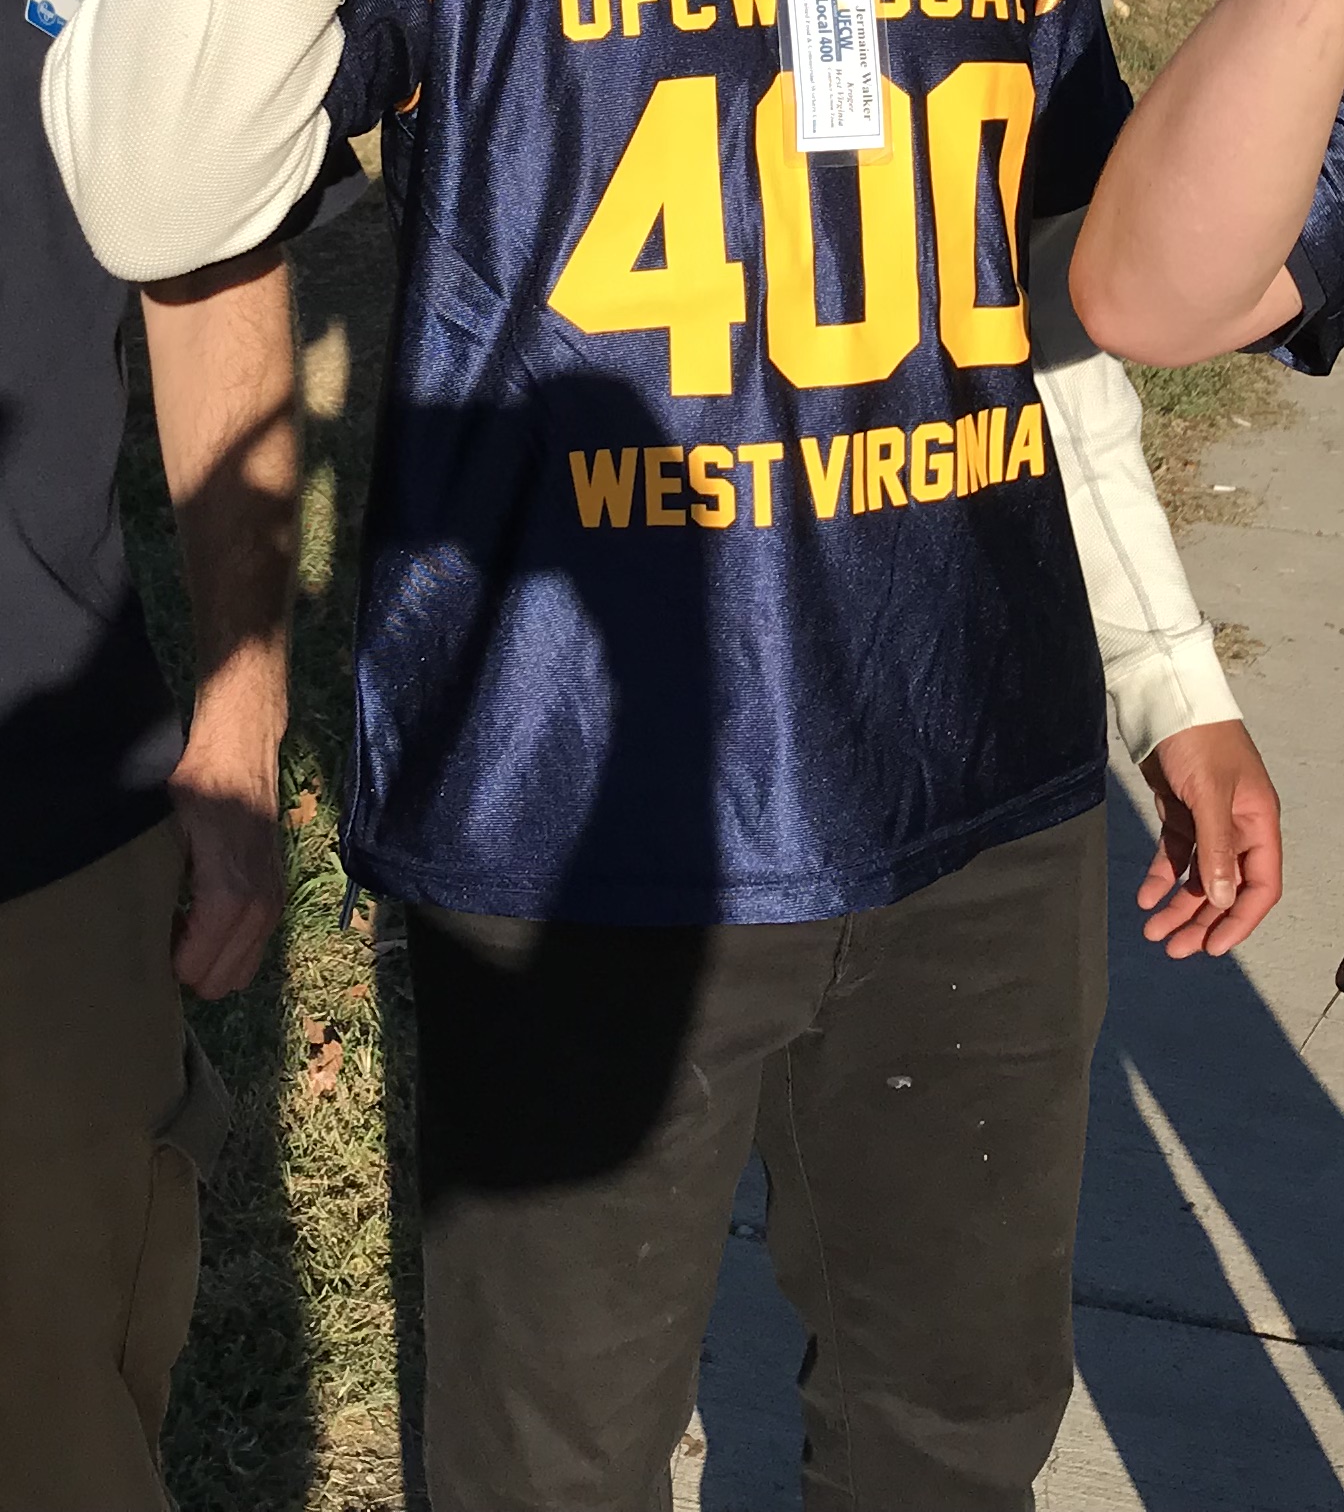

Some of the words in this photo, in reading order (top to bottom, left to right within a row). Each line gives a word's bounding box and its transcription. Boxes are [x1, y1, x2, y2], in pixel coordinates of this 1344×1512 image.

[819, 36, 834, 63] 400
[837, 7, 854, 51] UFCW
[855, 4, 870, 68] Jermaine
[860, 71, 874, 122] Walker
[546, 61, 1036, 398] 400
[568, 442, 785, 530] WEST
[799, 403, 1046, 520] VIRGINIA
